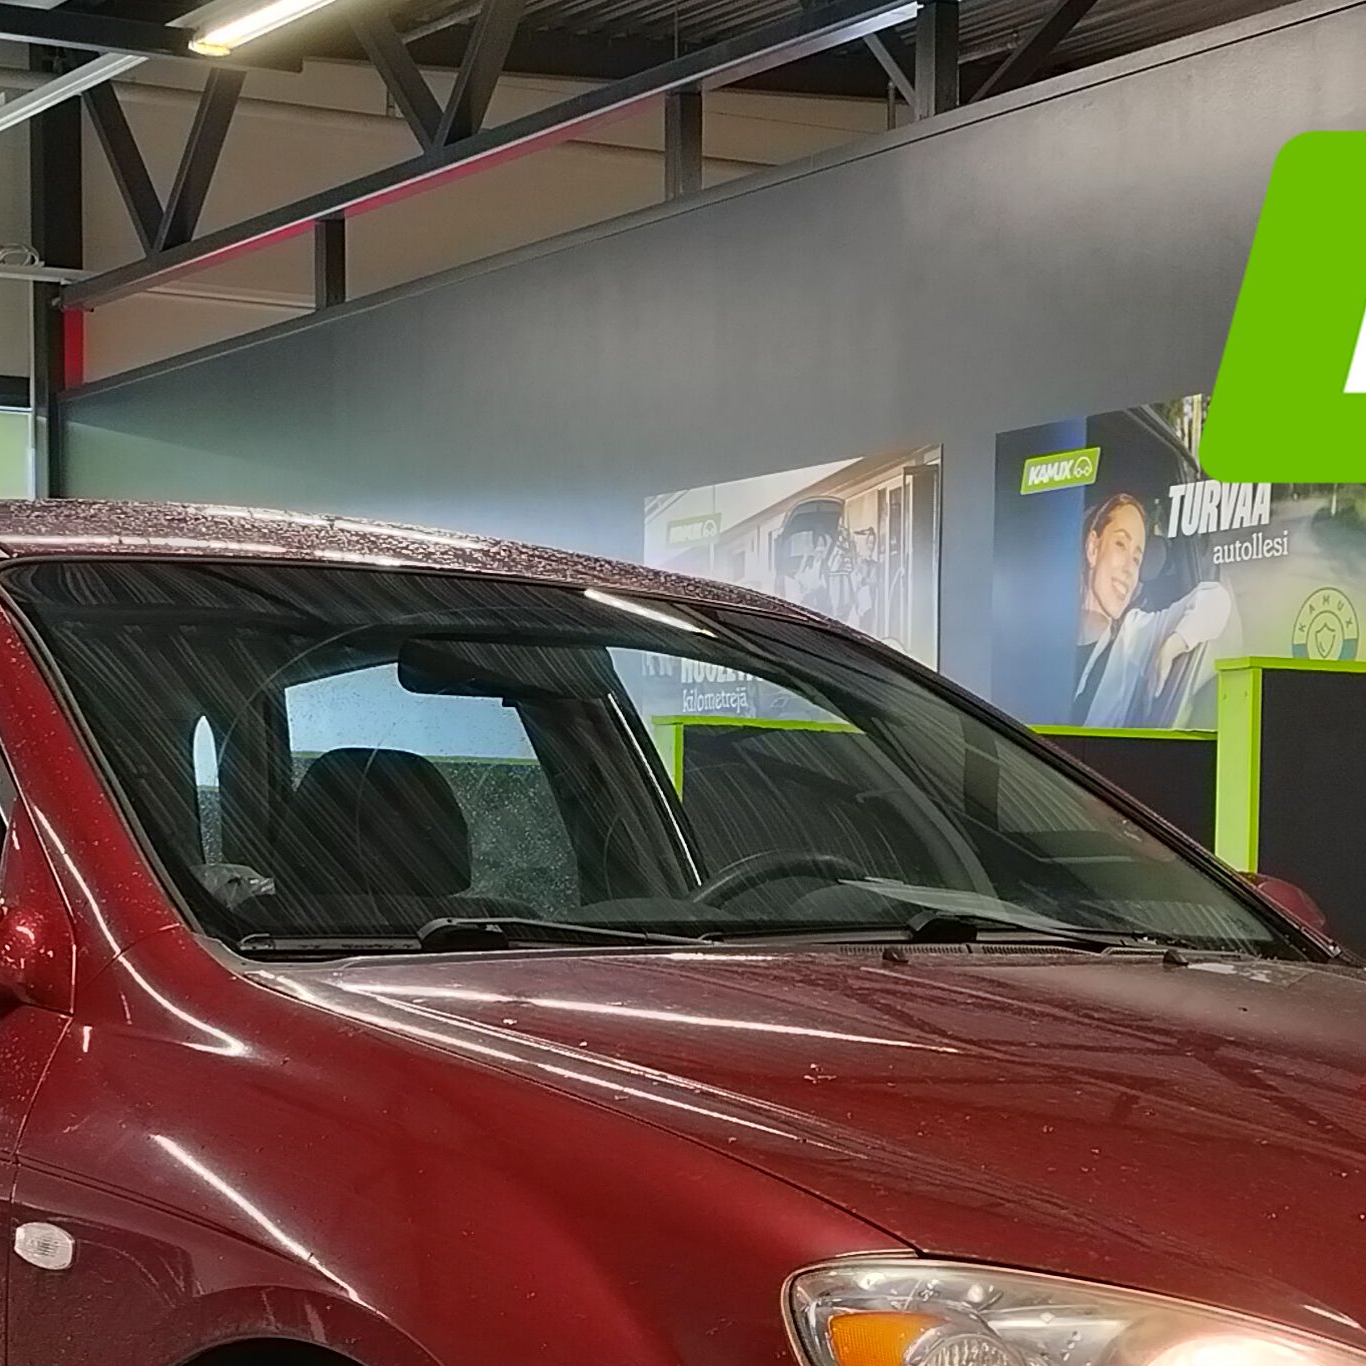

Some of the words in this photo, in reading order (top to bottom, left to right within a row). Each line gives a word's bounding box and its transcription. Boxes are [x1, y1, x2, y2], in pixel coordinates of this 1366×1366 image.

[1028, 460, 1075, 486] KAMUX
[1167, 480, 1272, 538] TURVAA
[1213, 530, 1289, 564] autollesi
[682, 686, 748, 714] kilometrejä
